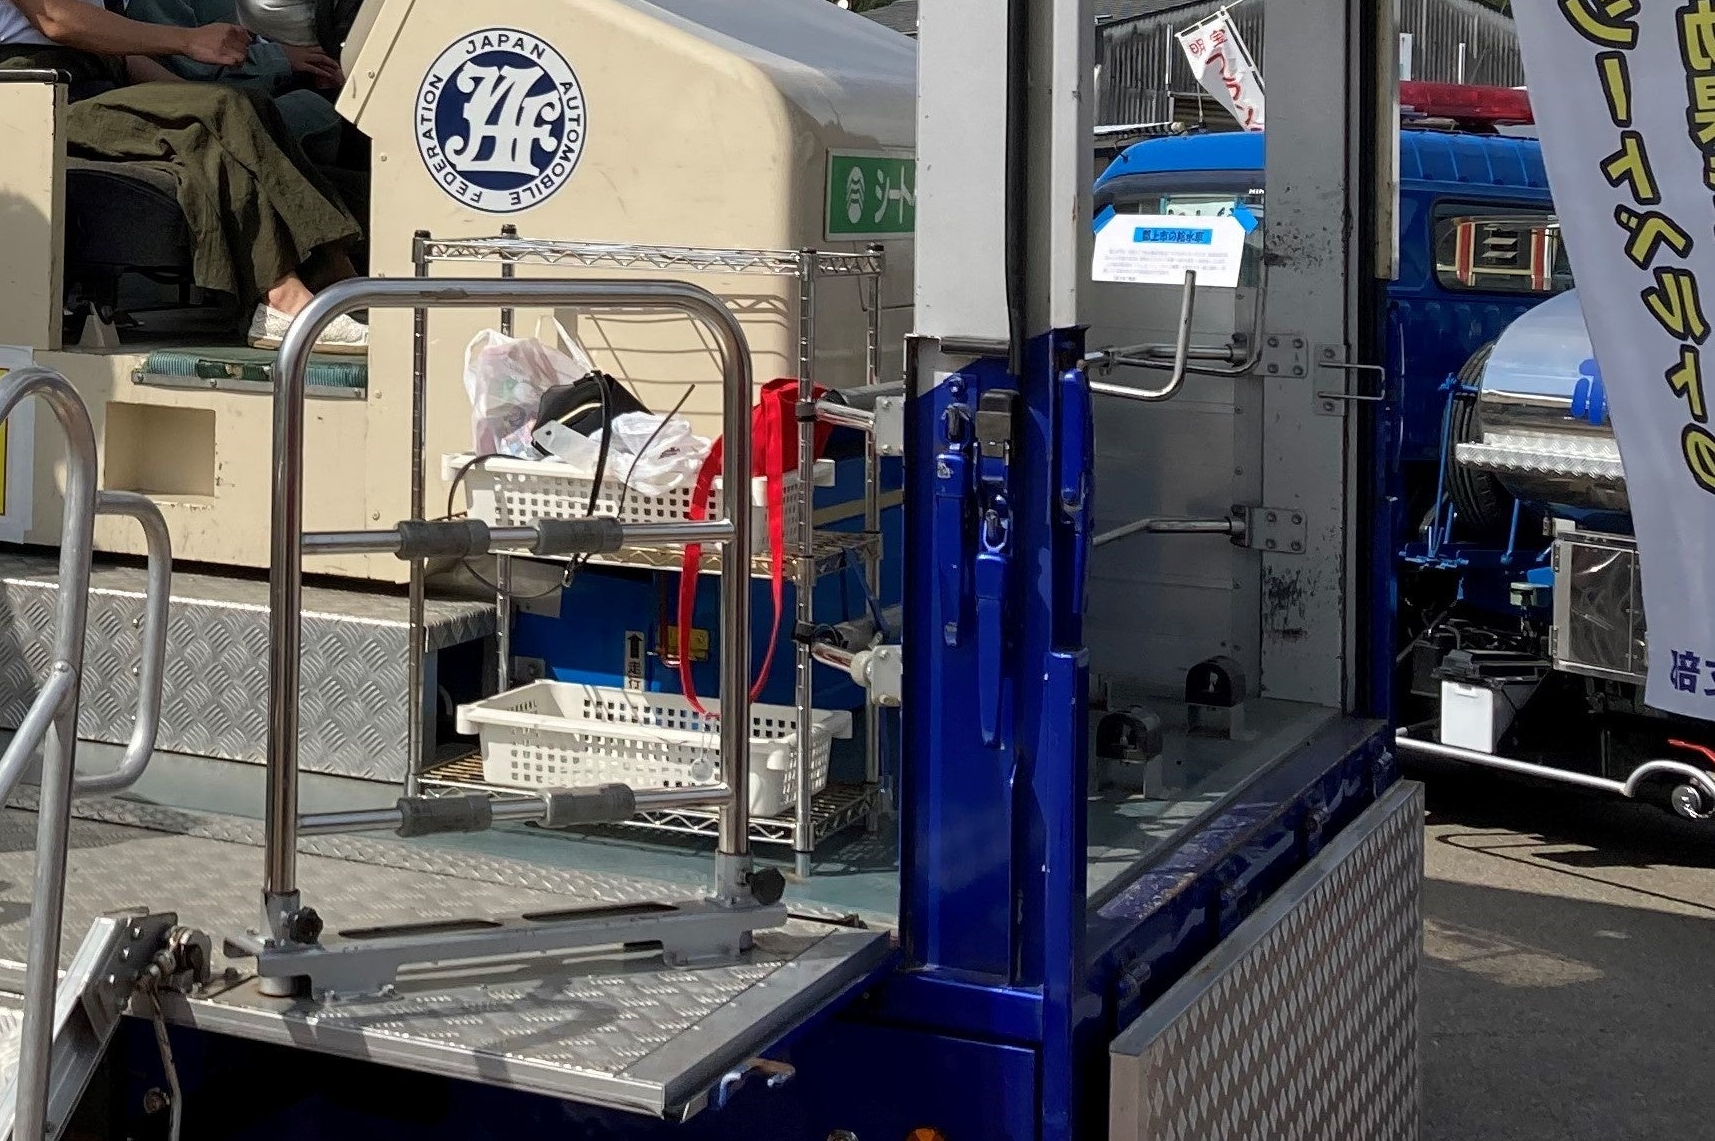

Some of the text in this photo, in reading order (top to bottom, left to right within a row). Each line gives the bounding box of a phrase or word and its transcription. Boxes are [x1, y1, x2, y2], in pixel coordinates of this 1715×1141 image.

[466, 33, 546, 60] JAPAN
[420, 74, 484, 204] FEDERATION
[509, 81, 581, 206] AUTOMOBILE
